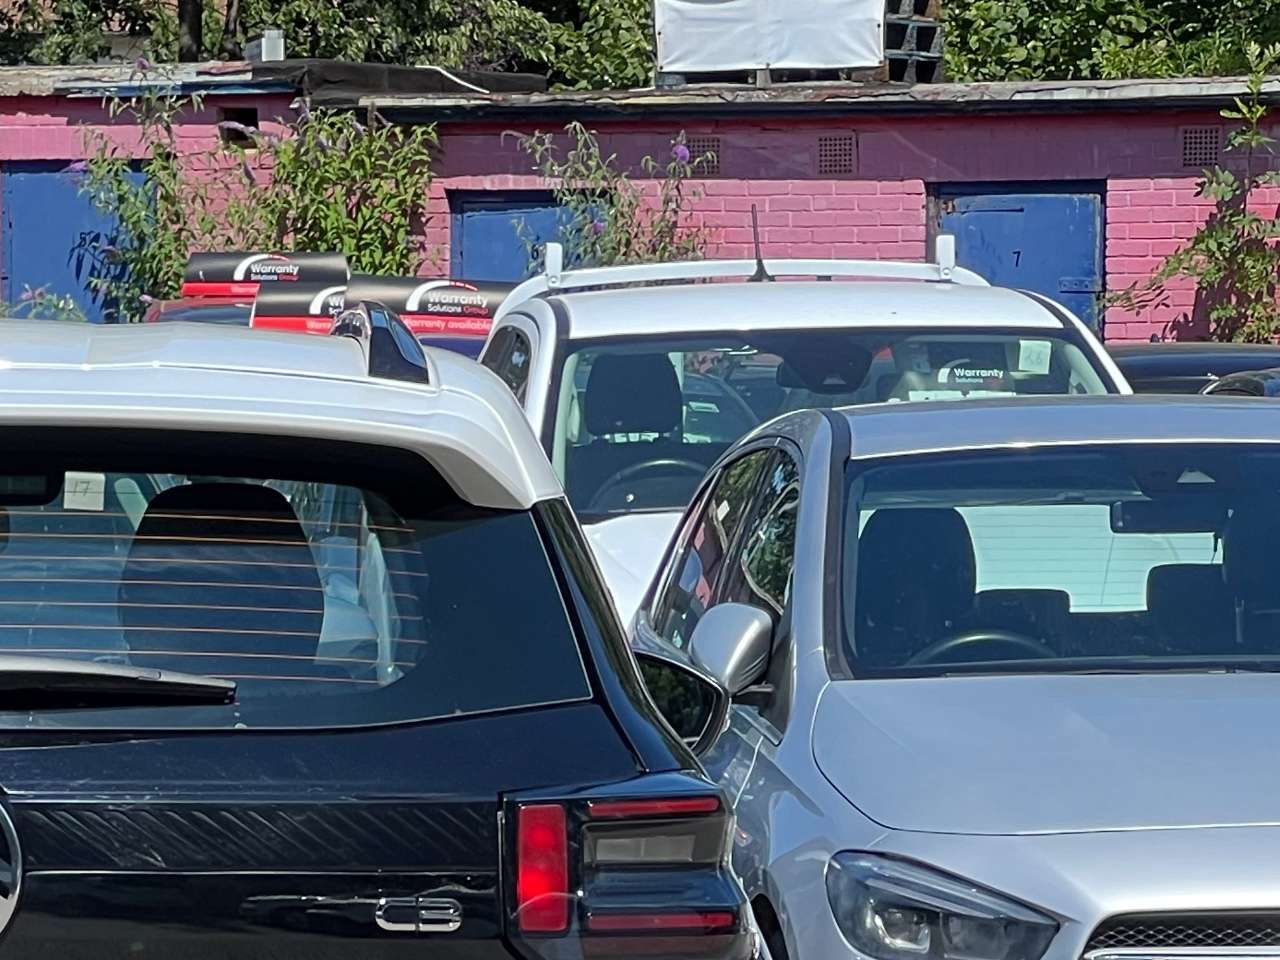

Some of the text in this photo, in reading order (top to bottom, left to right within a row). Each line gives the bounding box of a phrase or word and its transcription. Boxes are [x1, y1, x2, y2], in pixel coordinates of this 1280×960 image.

[1012, 250, 1021, 267] 7
[251, 263, 299, 276] Warranty
[428, 292, 488, 308] Warranty
[428, 304, 461, 312] Solutions
[954, 368, 1004, 378] Warranty
